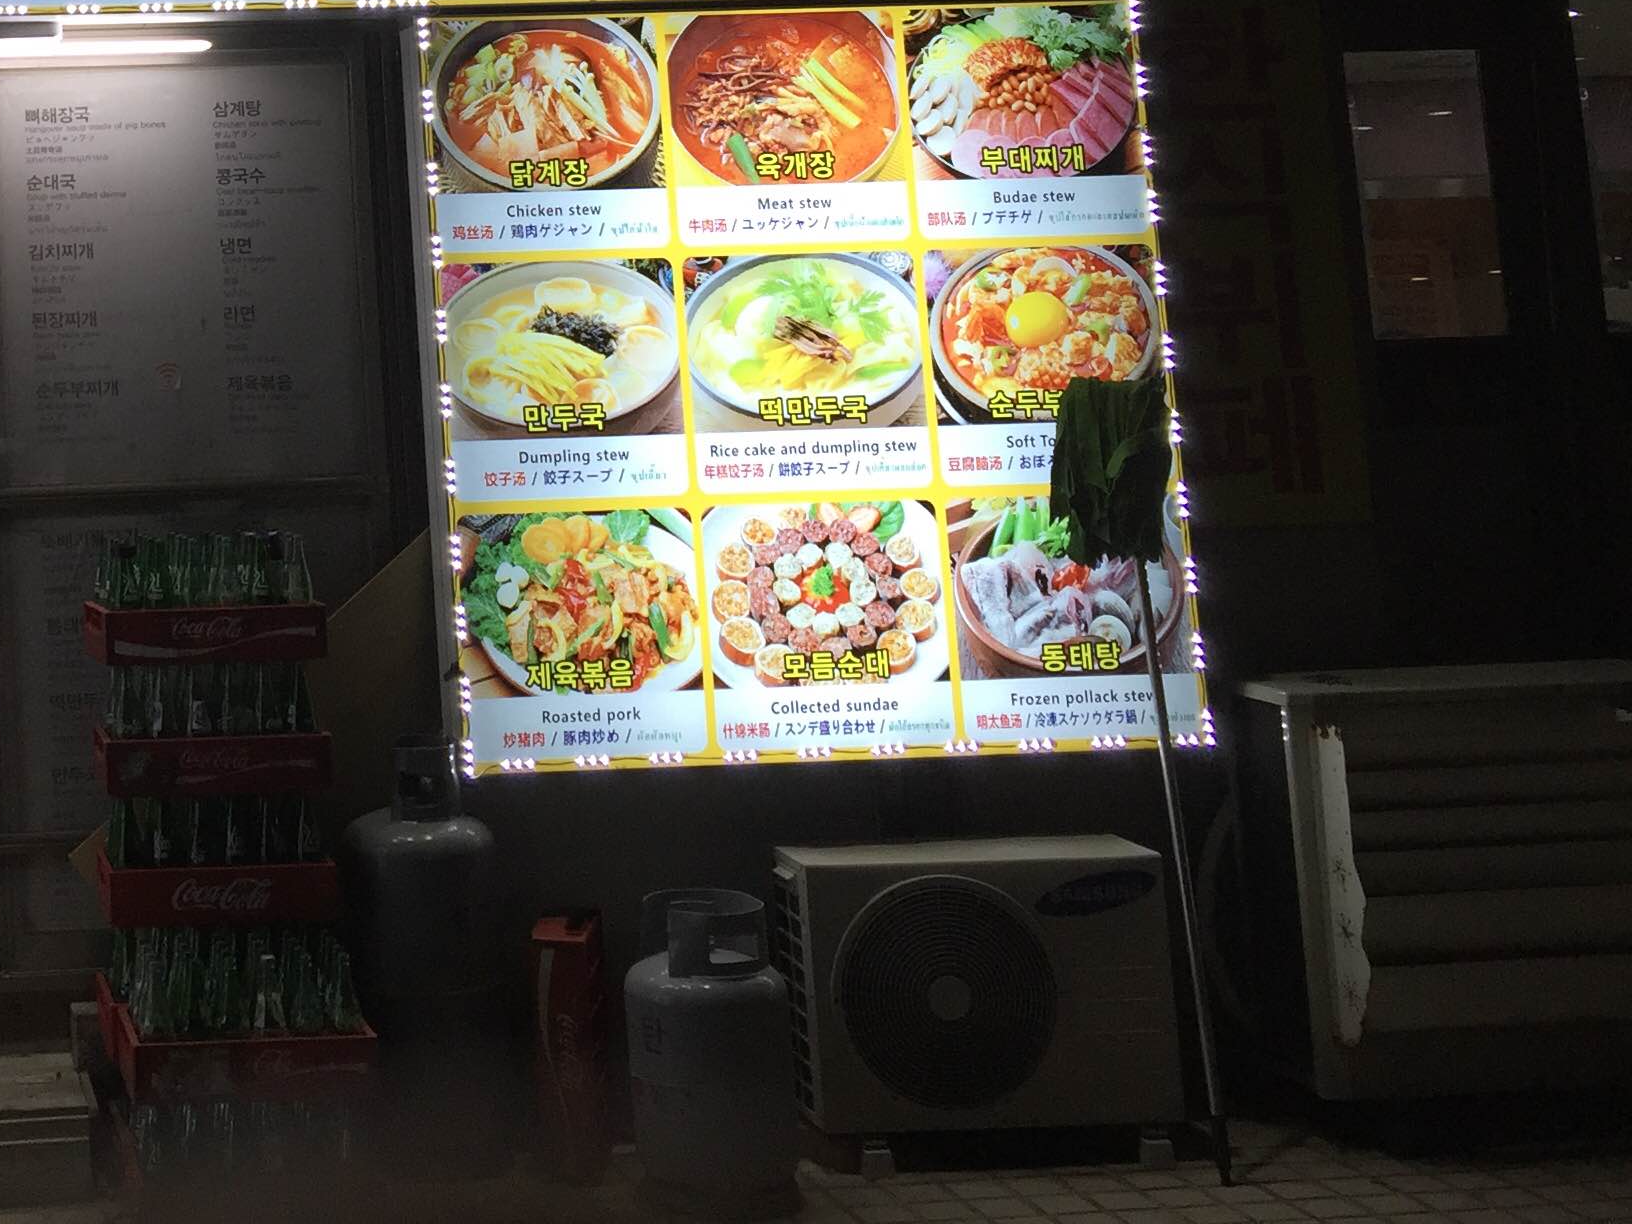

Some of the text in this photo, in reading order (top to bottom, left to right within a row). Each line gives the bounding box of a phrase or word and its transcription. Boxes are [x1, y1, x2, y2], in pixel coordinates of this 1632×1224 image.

[212, 100, 261, 118] 삼계탕
[755, 151, 836, 180] 육개장
[979, 143, 1087, 174] 부대찌개
[27, 173, 76, 191] 순대국
[509, 157, 589, 189] 닭계장
[758, 197, 832, 211] Meat stew
[993, 188, 1076, 204] Budae stew
[506, 204, 602, 218] Chicken stew
[29, 243, 94, 261] 김치찌개
[220, 237, 252, 255] 냉면
[757, 394, 870, 427] 떡만두국
[987, 389, 1064, 420] 순두부
[522, 402, 607, 434] 만두국
[710, 439, 917, 458] Rice cake and dumpling stew
[1007, 435, 1035, 448] Soft
[519, 449, 630, 466] Dumpling stew
[782, 649, 891, 681] 모듬순대
[1041, 642, 1121, 673] 동태탕
[526, 659, 634, 690] 제육볶음
[771, 698, 899, 715] Collected sundae
[1011, 692, 1060, 706] Frozen
[1066, 690, 1118, 707] pollack
[542, 707, 640, 724] Roasted pork
